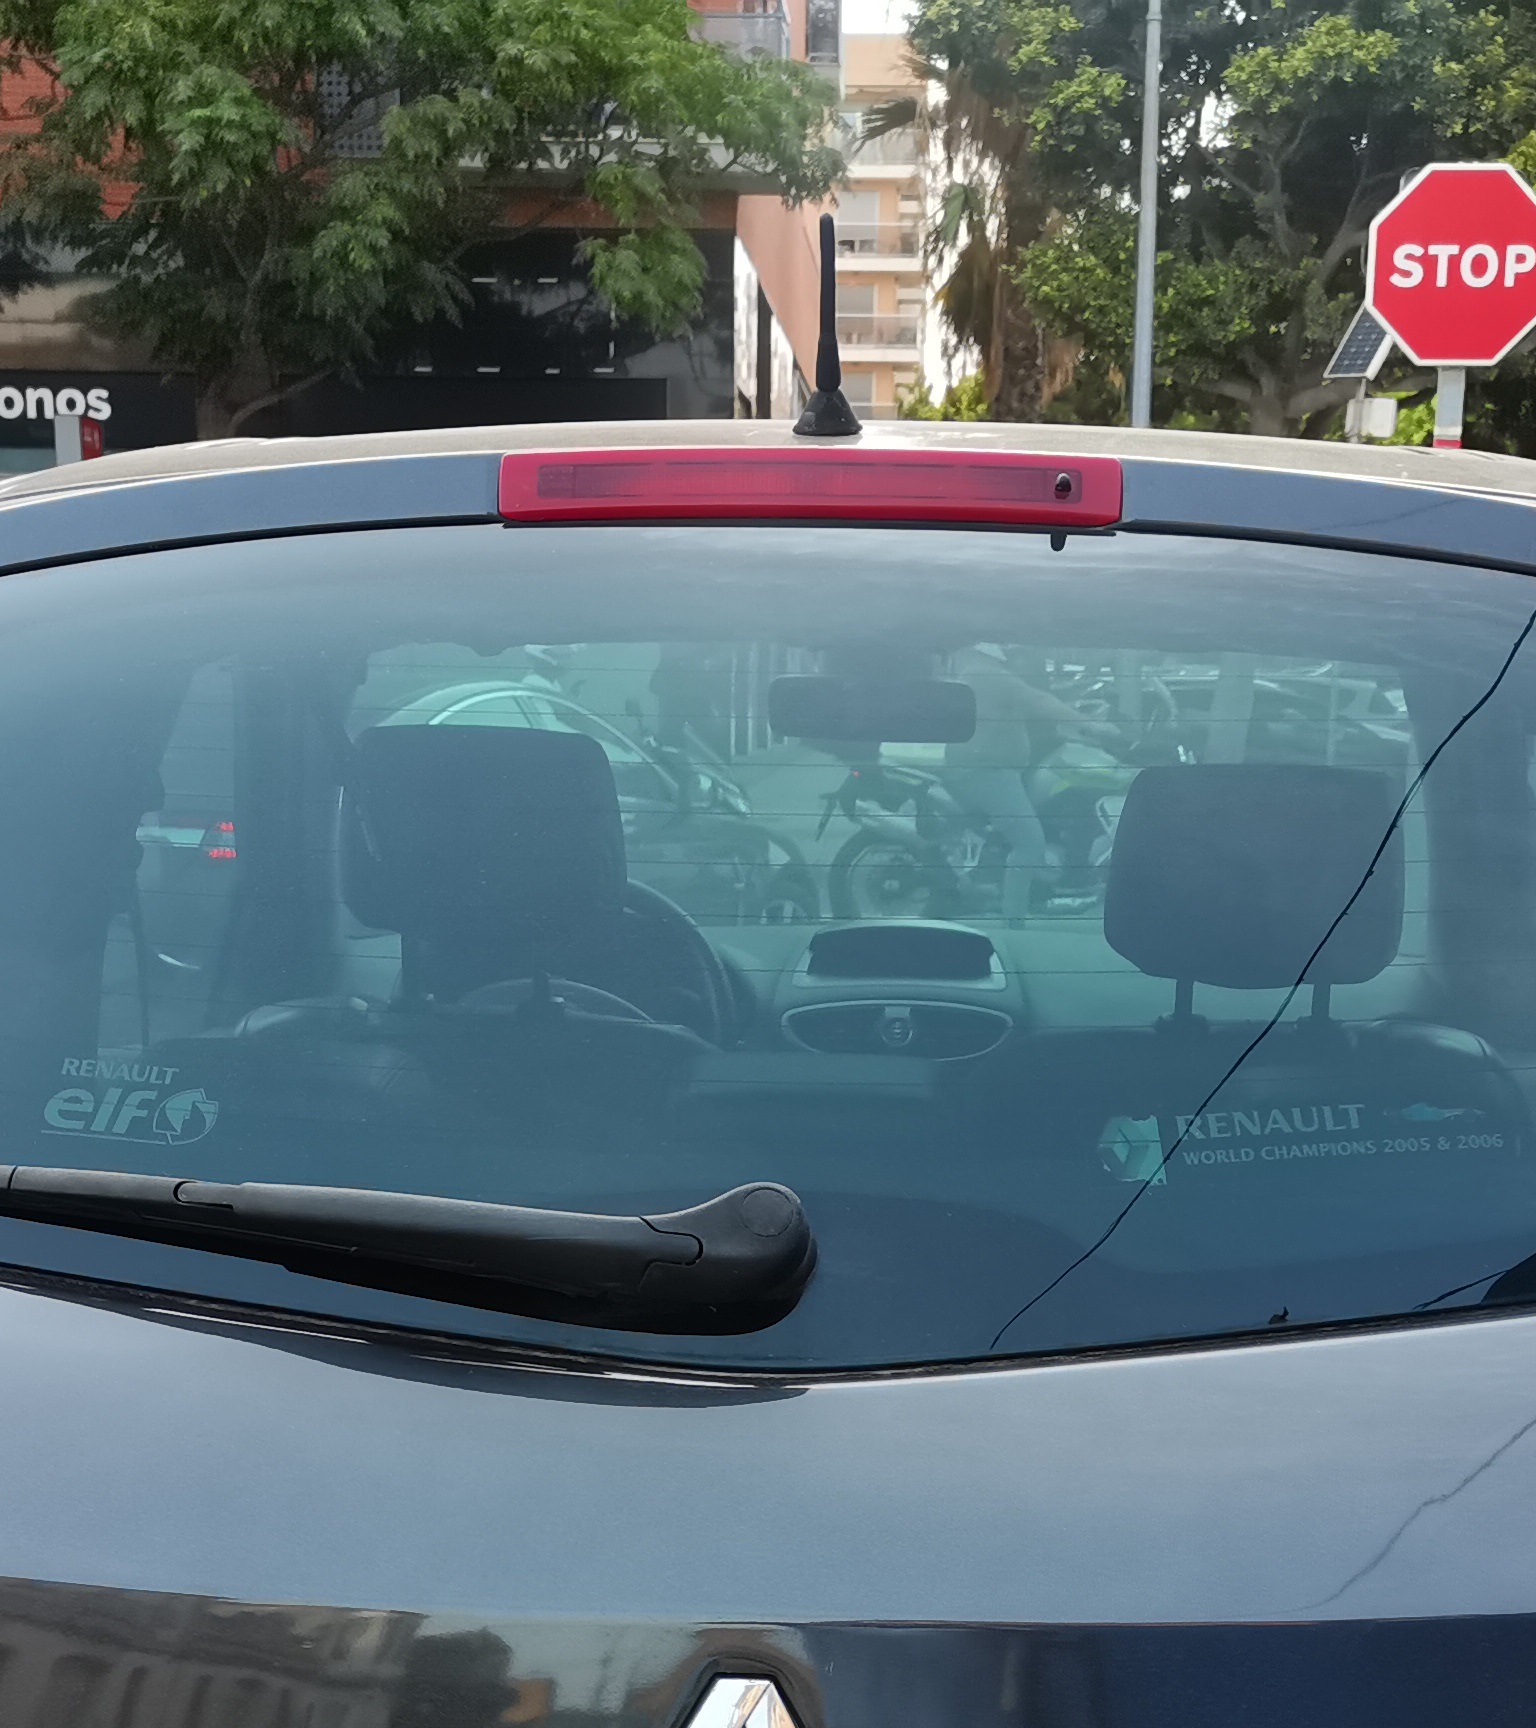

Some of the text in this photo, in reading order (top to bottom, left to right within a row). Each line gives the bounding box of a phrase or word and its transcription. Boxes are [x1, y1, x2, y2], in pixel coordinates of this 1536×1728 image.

[60, 1057, 180, 1085] RENAULT
[43, 1088, 159, 1135] elf
[1175, 1103, 1366, 1142] RENAULT
[1182, 1133, 1505, 1166] WORLD CHAMPIONS 2005 & 2006
